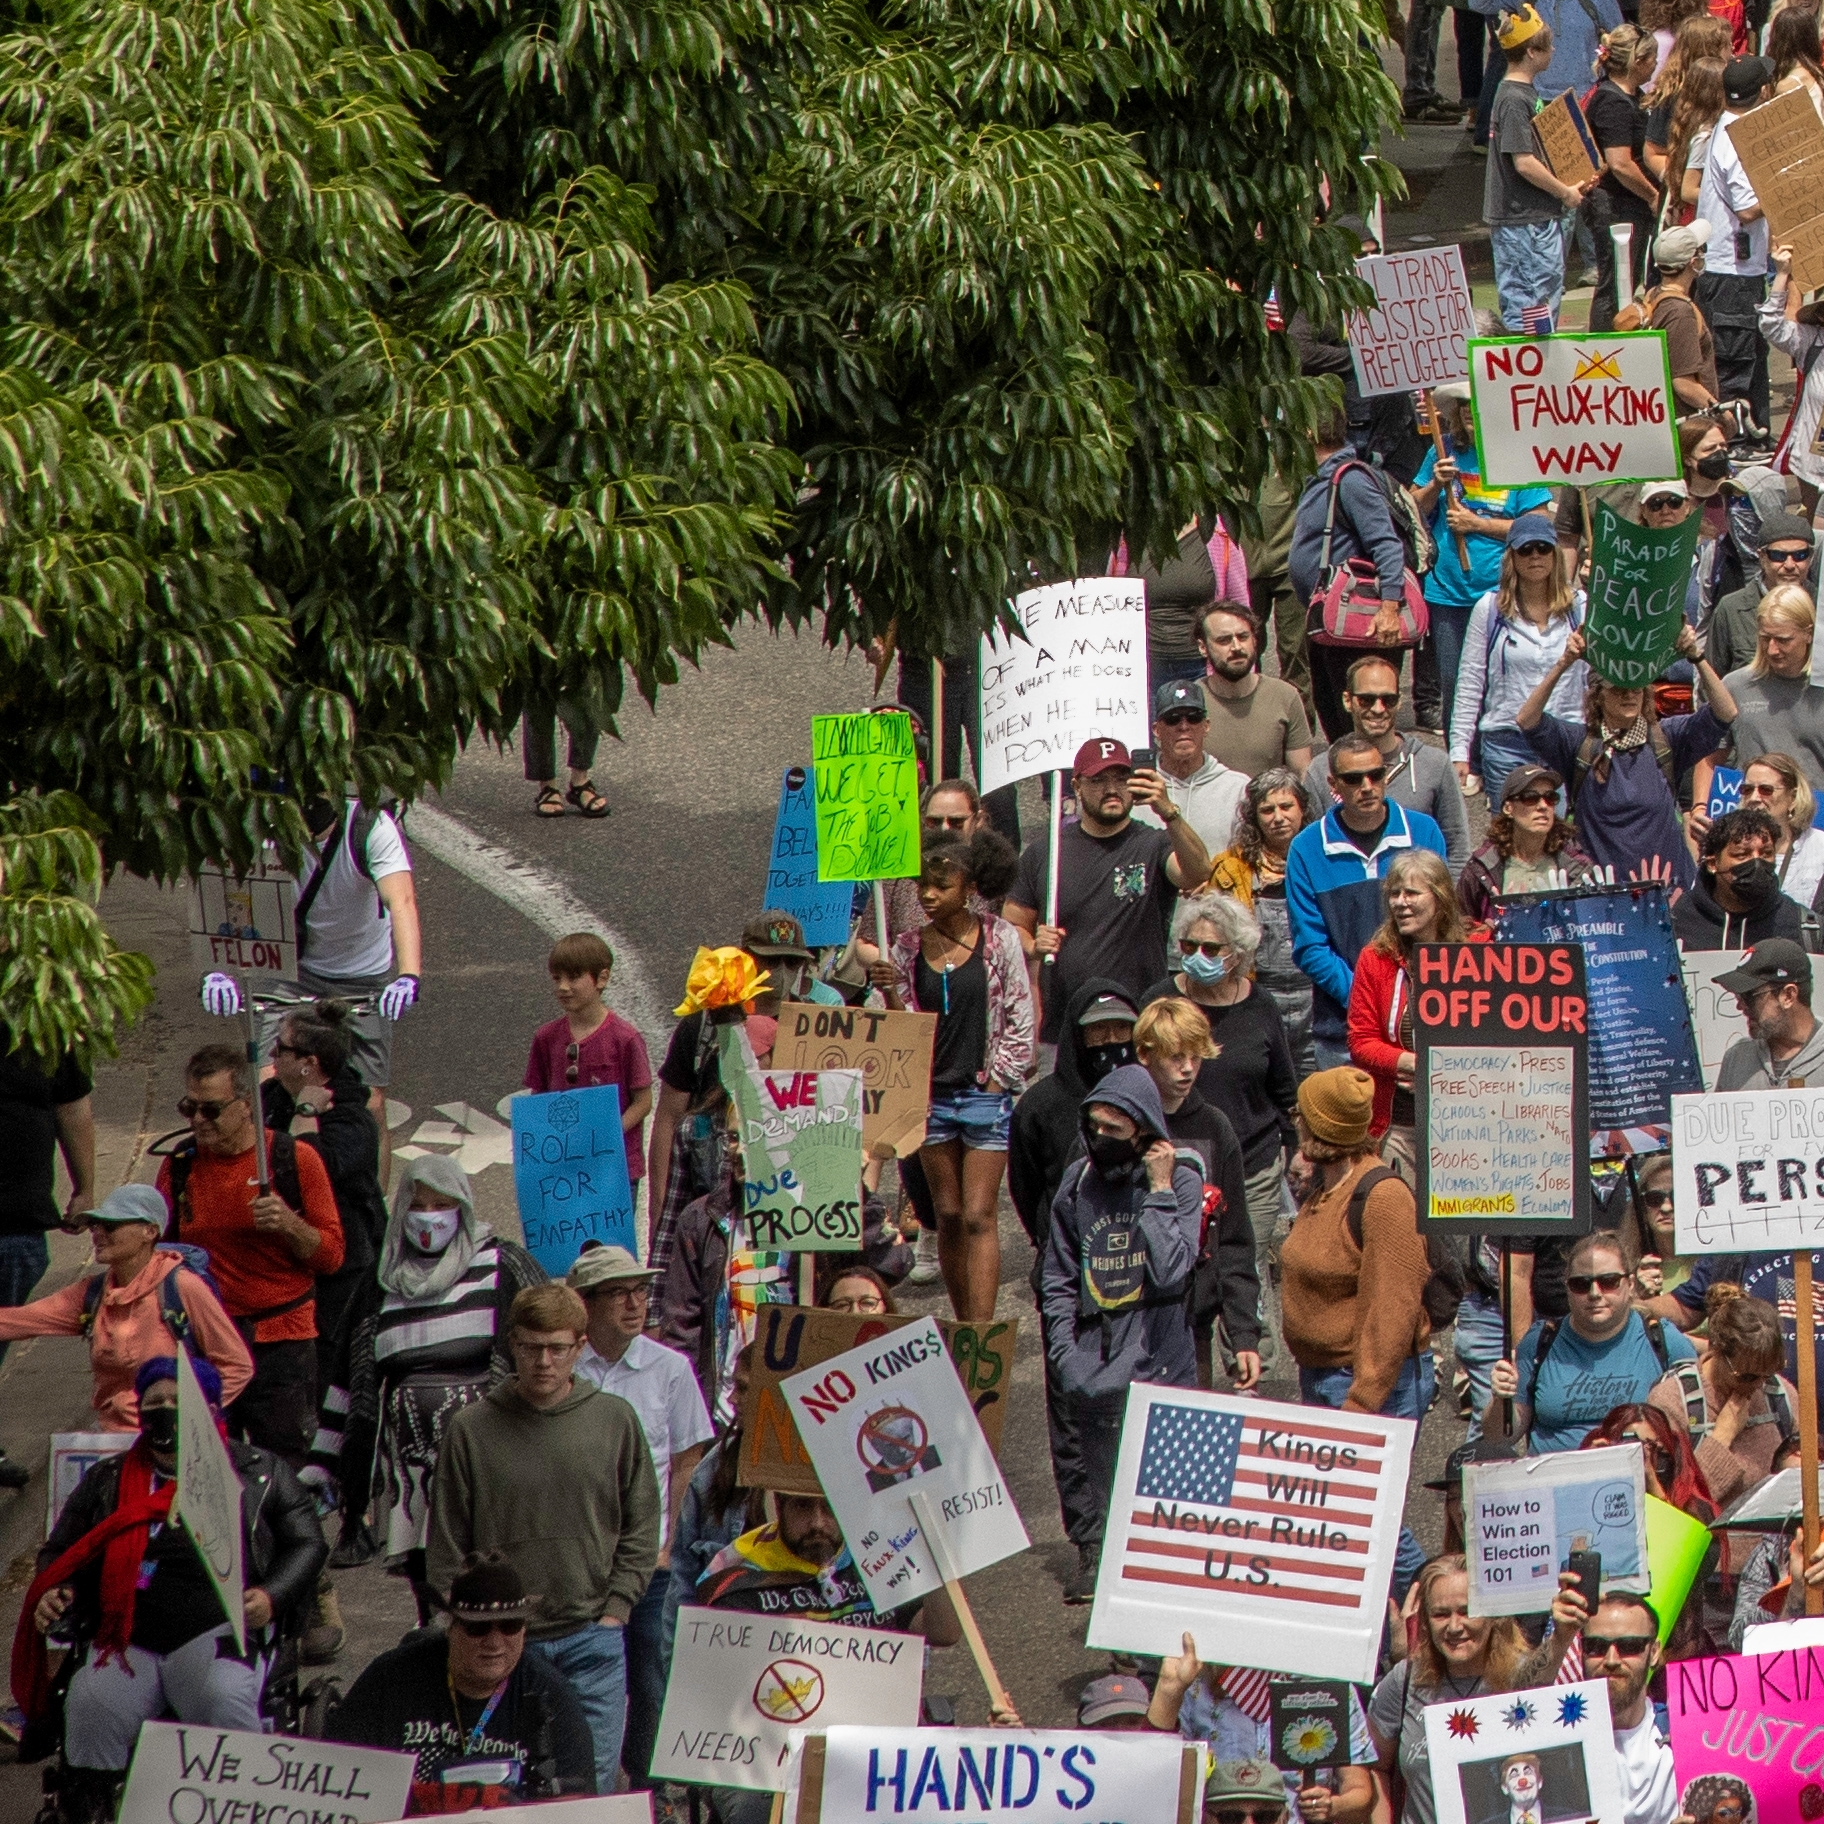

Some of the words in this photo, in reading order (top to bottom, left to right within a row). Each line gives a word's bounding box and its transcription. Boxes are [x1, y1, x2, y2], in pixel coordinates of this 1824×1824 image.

[1485, 345, 1543, 380] NO
[1512, 385, 1664, 431] FAUX-KING
[1533, 442, 1622, 474] WAY
[1419, 947, 1573, 987] HANDS
[1419, 989, 1490, 1026] OFF
[1501, 995, 1586, 1033] OUR
[521, 1132, 614, 1166] ROLL
[540, 1173, 598, 1202] FOR
[522, 1207, 627, 1251] EMPATHY
[1257, 1429, 1359, 1472] Kings
[1266, 1473, 1329, 1507] Will
[1152, 1503, 1259, 1543] Never
[1269, 1518, 1348, 1552] Rule
[1202, 1551, 1281, 1588] U.S.
[866, 1746, 1096, 1814] HAND'S
